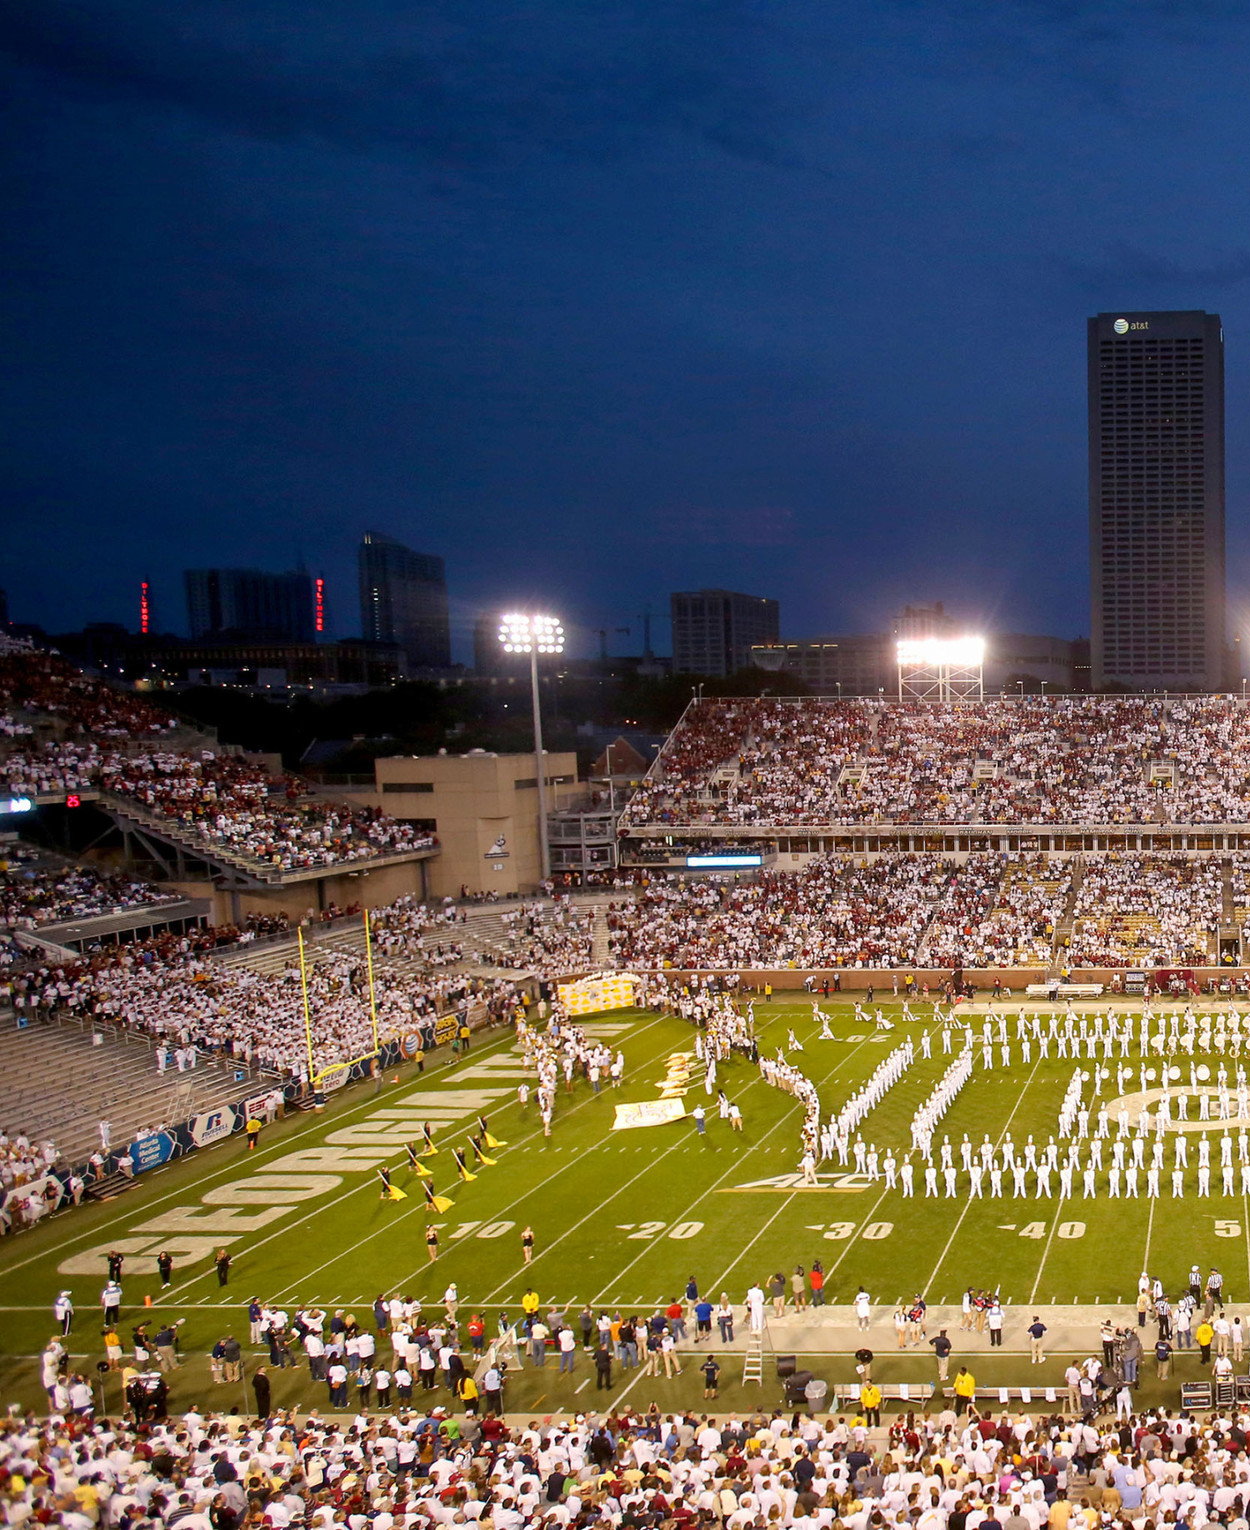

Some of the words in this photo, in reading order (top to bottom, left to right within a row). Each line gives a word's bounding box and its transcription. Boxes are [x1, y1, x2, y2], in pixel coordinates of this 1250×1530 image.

[1130, 321, 1150, 330] at&t
[141, 582, 149, 633] BILTMORE
[316, 579, 324, 631] BILTMORE
[139, 1138, 159, 1150] Atlanta
[139, 1144, 160, 1157] Medical
[141, 1152, 160, 1163] Center
[57, 1087, 516, 1276] GEORGIA
[734, 1172, 888, 1189] ACC
[447, 1220, 517, 1239] 10
[626, 1220, 705, 1240] 20
[823, 1221, 895, 1241] 30
[1017, 1221, 1088, 1240] 40
